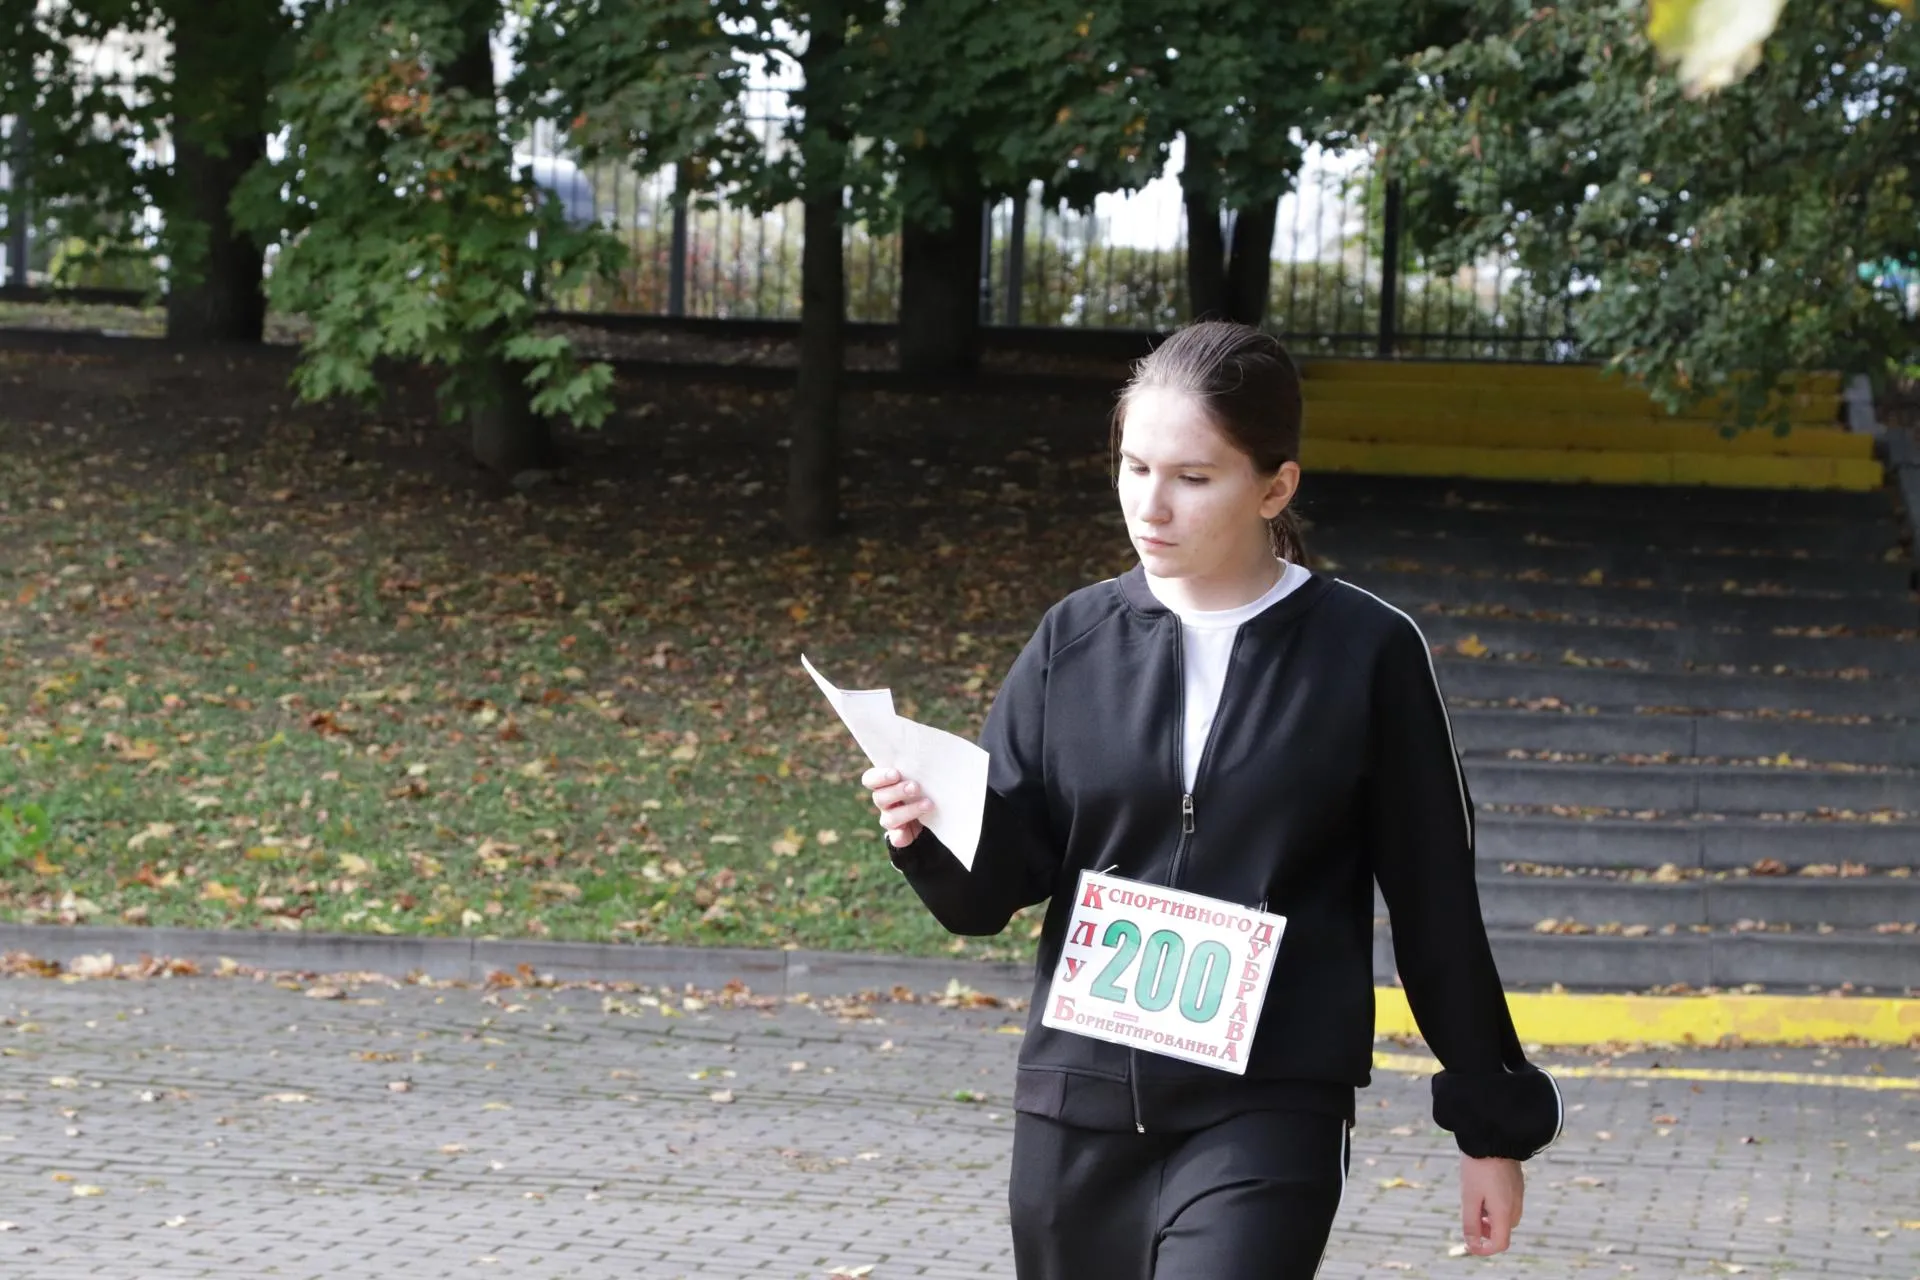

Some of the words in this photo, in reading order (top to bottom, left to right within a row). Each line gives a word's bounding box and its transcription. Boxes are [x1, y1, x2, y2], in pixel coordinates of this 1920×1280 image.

[1052, 883, 1106, 1022] КЛУБ
[1108, 888, 1252, 932] СПОРТИВНОГО
[1089, 919, 1231, 1023] 200
[1218, 922, 1275, 1062] ДУБРАВА
[1075, 1013, 1218, 1057] ОРИЕНТИРОВАНИЯ
